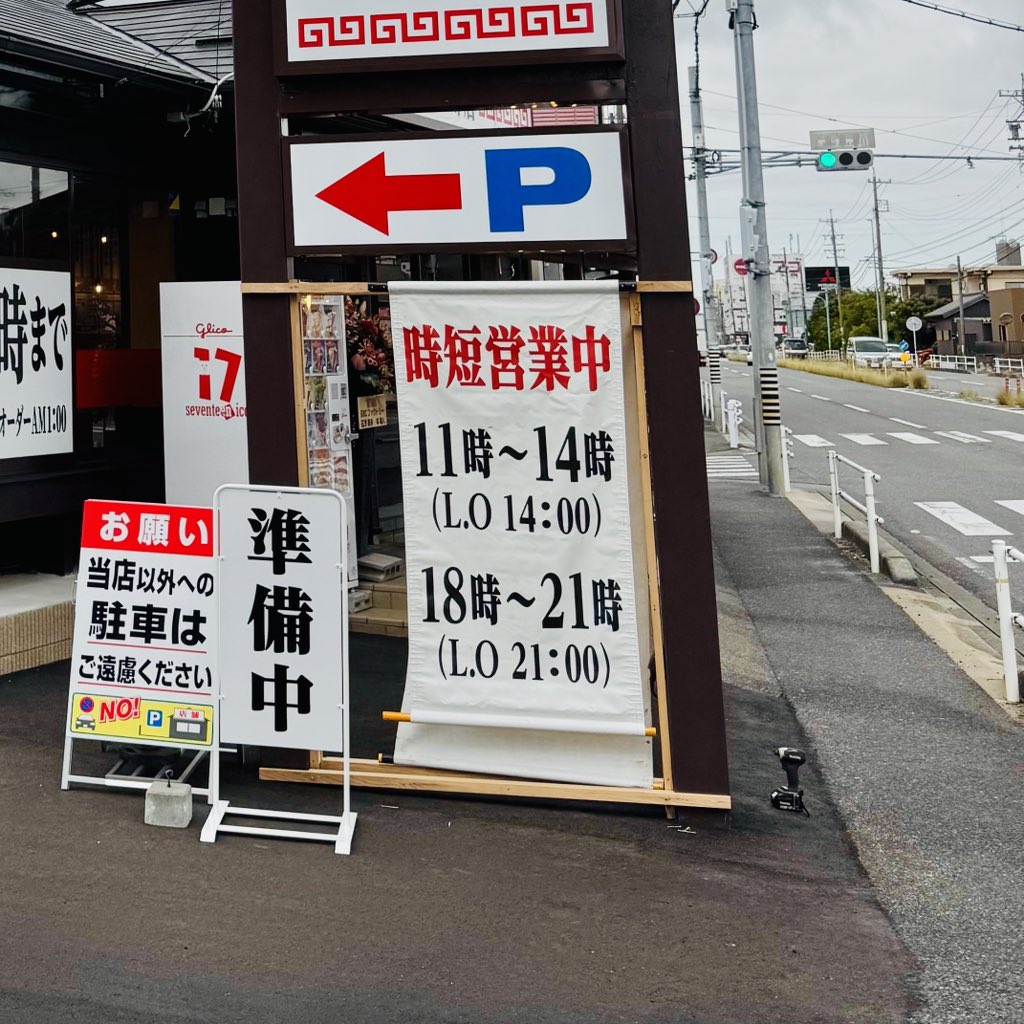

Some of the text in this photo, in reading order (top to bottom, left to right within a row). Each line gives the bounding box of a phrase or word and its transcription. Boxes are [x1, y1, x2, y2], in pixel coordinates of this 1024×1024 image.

[485, 147, 592, 232] P
[196, 323, 232, 339] Glico
[402, 324, 611, 392] 時短営業中
[99, 511, 209, 547] お願い
[87, 557, 214, 597] 当店以外への
[88, 600, 207, 646] 駐車は
[247, 507, 314, 732] 準備中
[78, 655, 212, 689] ご遠慮ください
[99, 697, 141, 722] NO!
